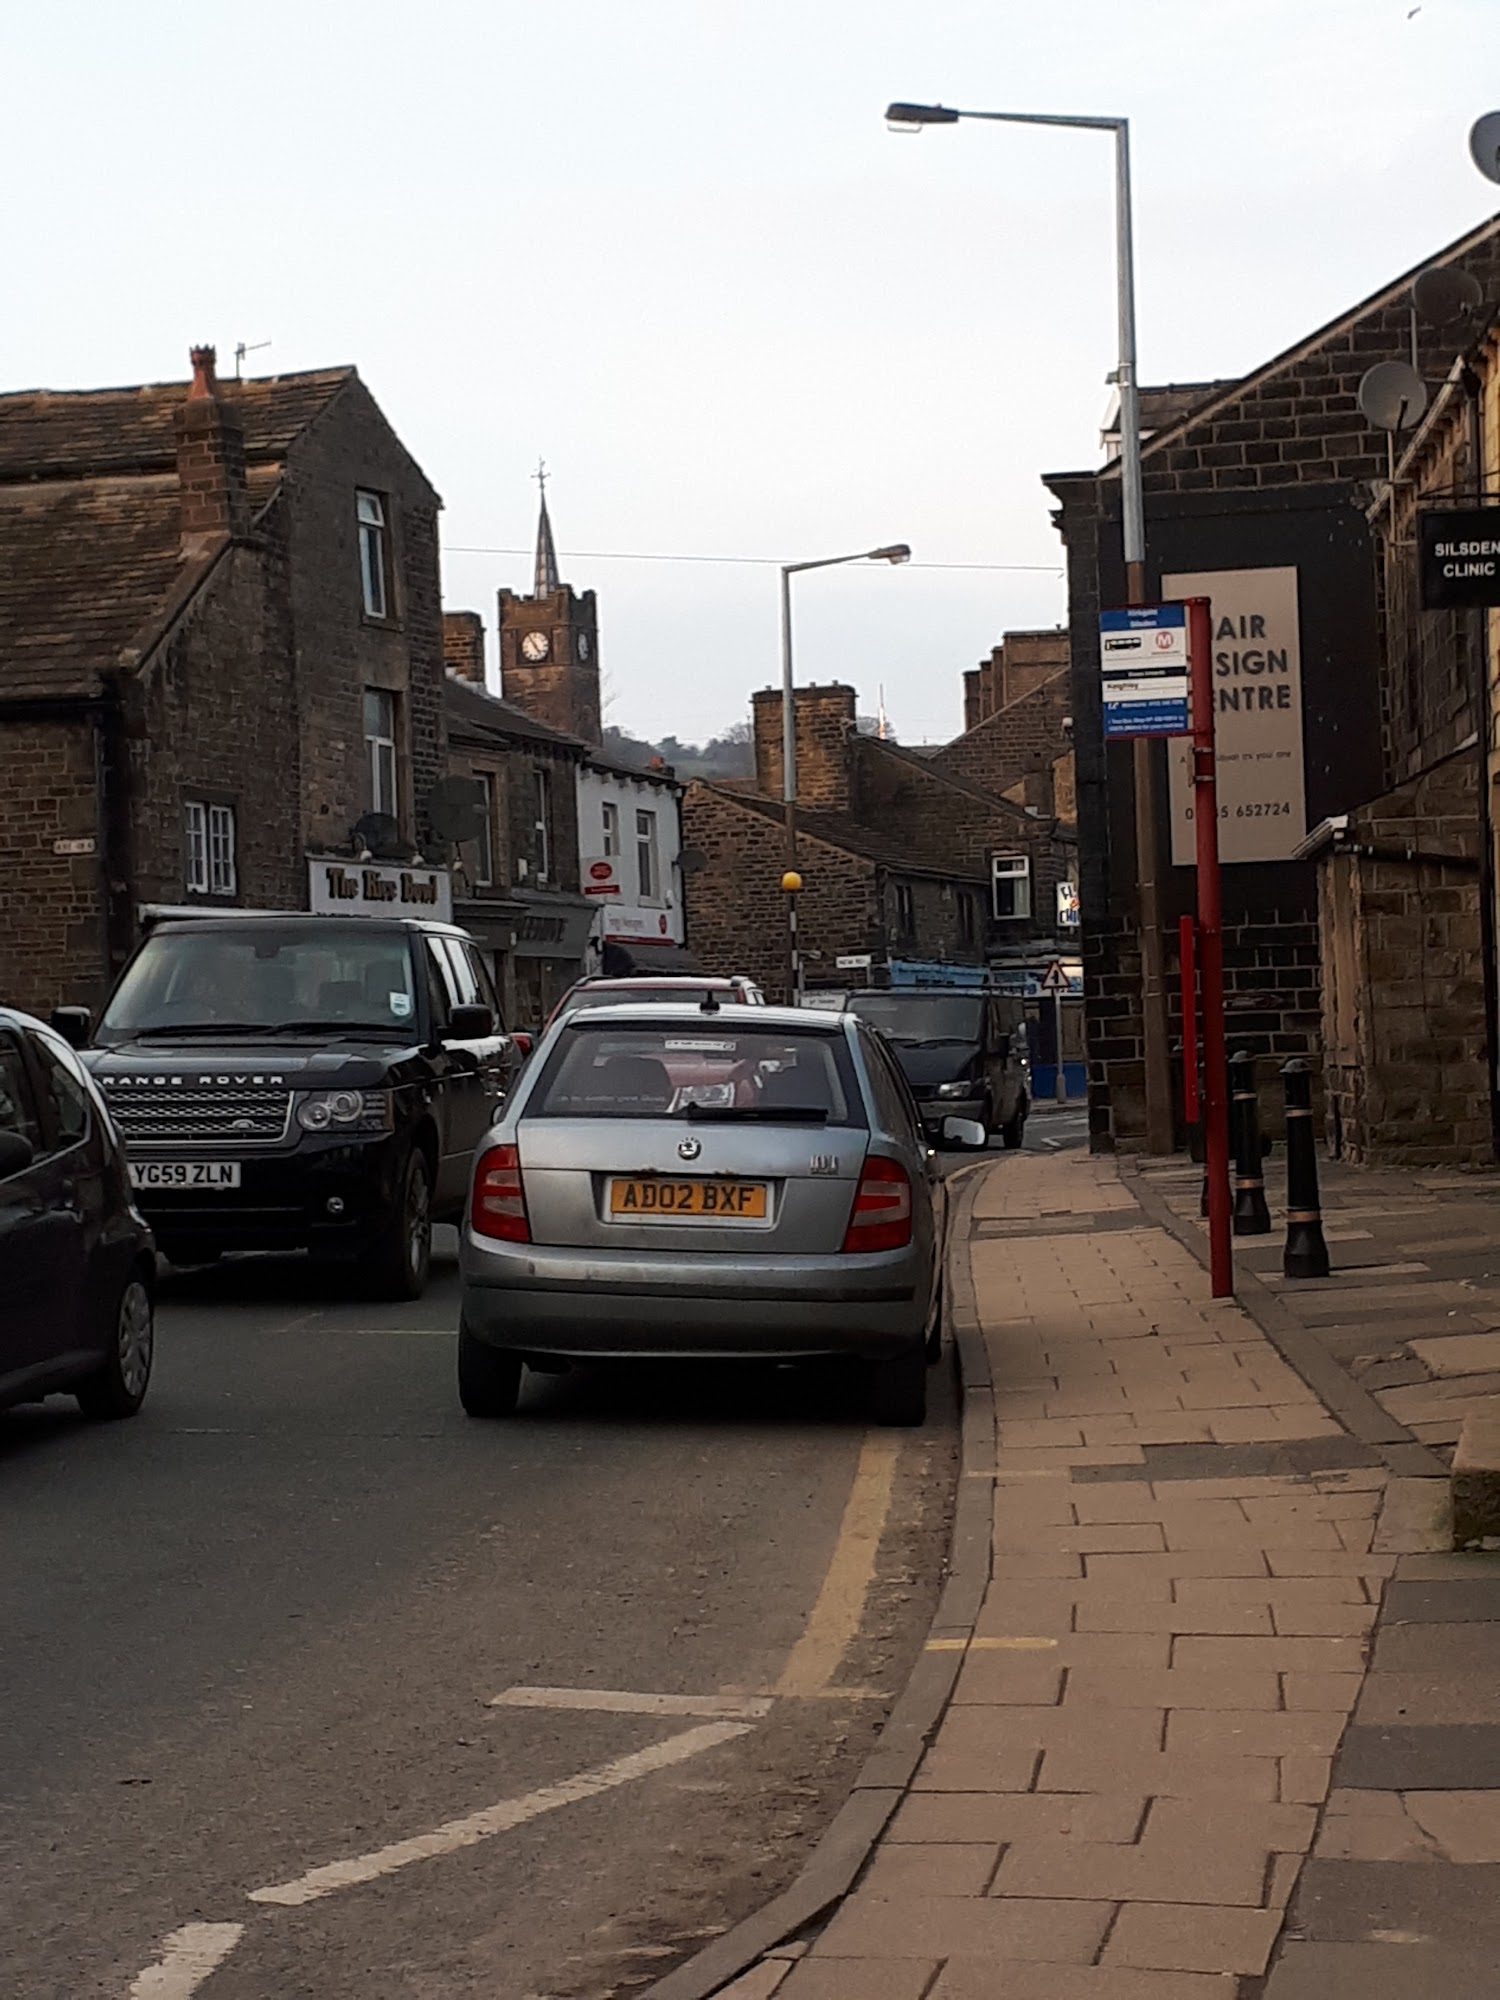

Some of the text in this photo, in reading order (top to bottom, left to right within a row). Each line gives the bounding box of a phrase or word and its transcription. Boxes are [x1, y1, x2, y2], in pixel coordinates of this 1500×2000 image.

[1434, 541, 1500, 557] SILSDEN
[1443, 562, 1496, 578] CLINIC
[1216, 614, 1266, 640] AIR
[1215, 648, 1288, 676] SIGN
[1219, 684, 1291, 712] NTRE
[1236, 802, 1290, 818] 652724
[326, 867, 438, 904] The Rice Bowl
[102, 1075, 284, 1085] RANGE ROVER
[134, 1165, 232, 1184] YG59 ZLN
[702, 1184, 755, 1212] BXF
